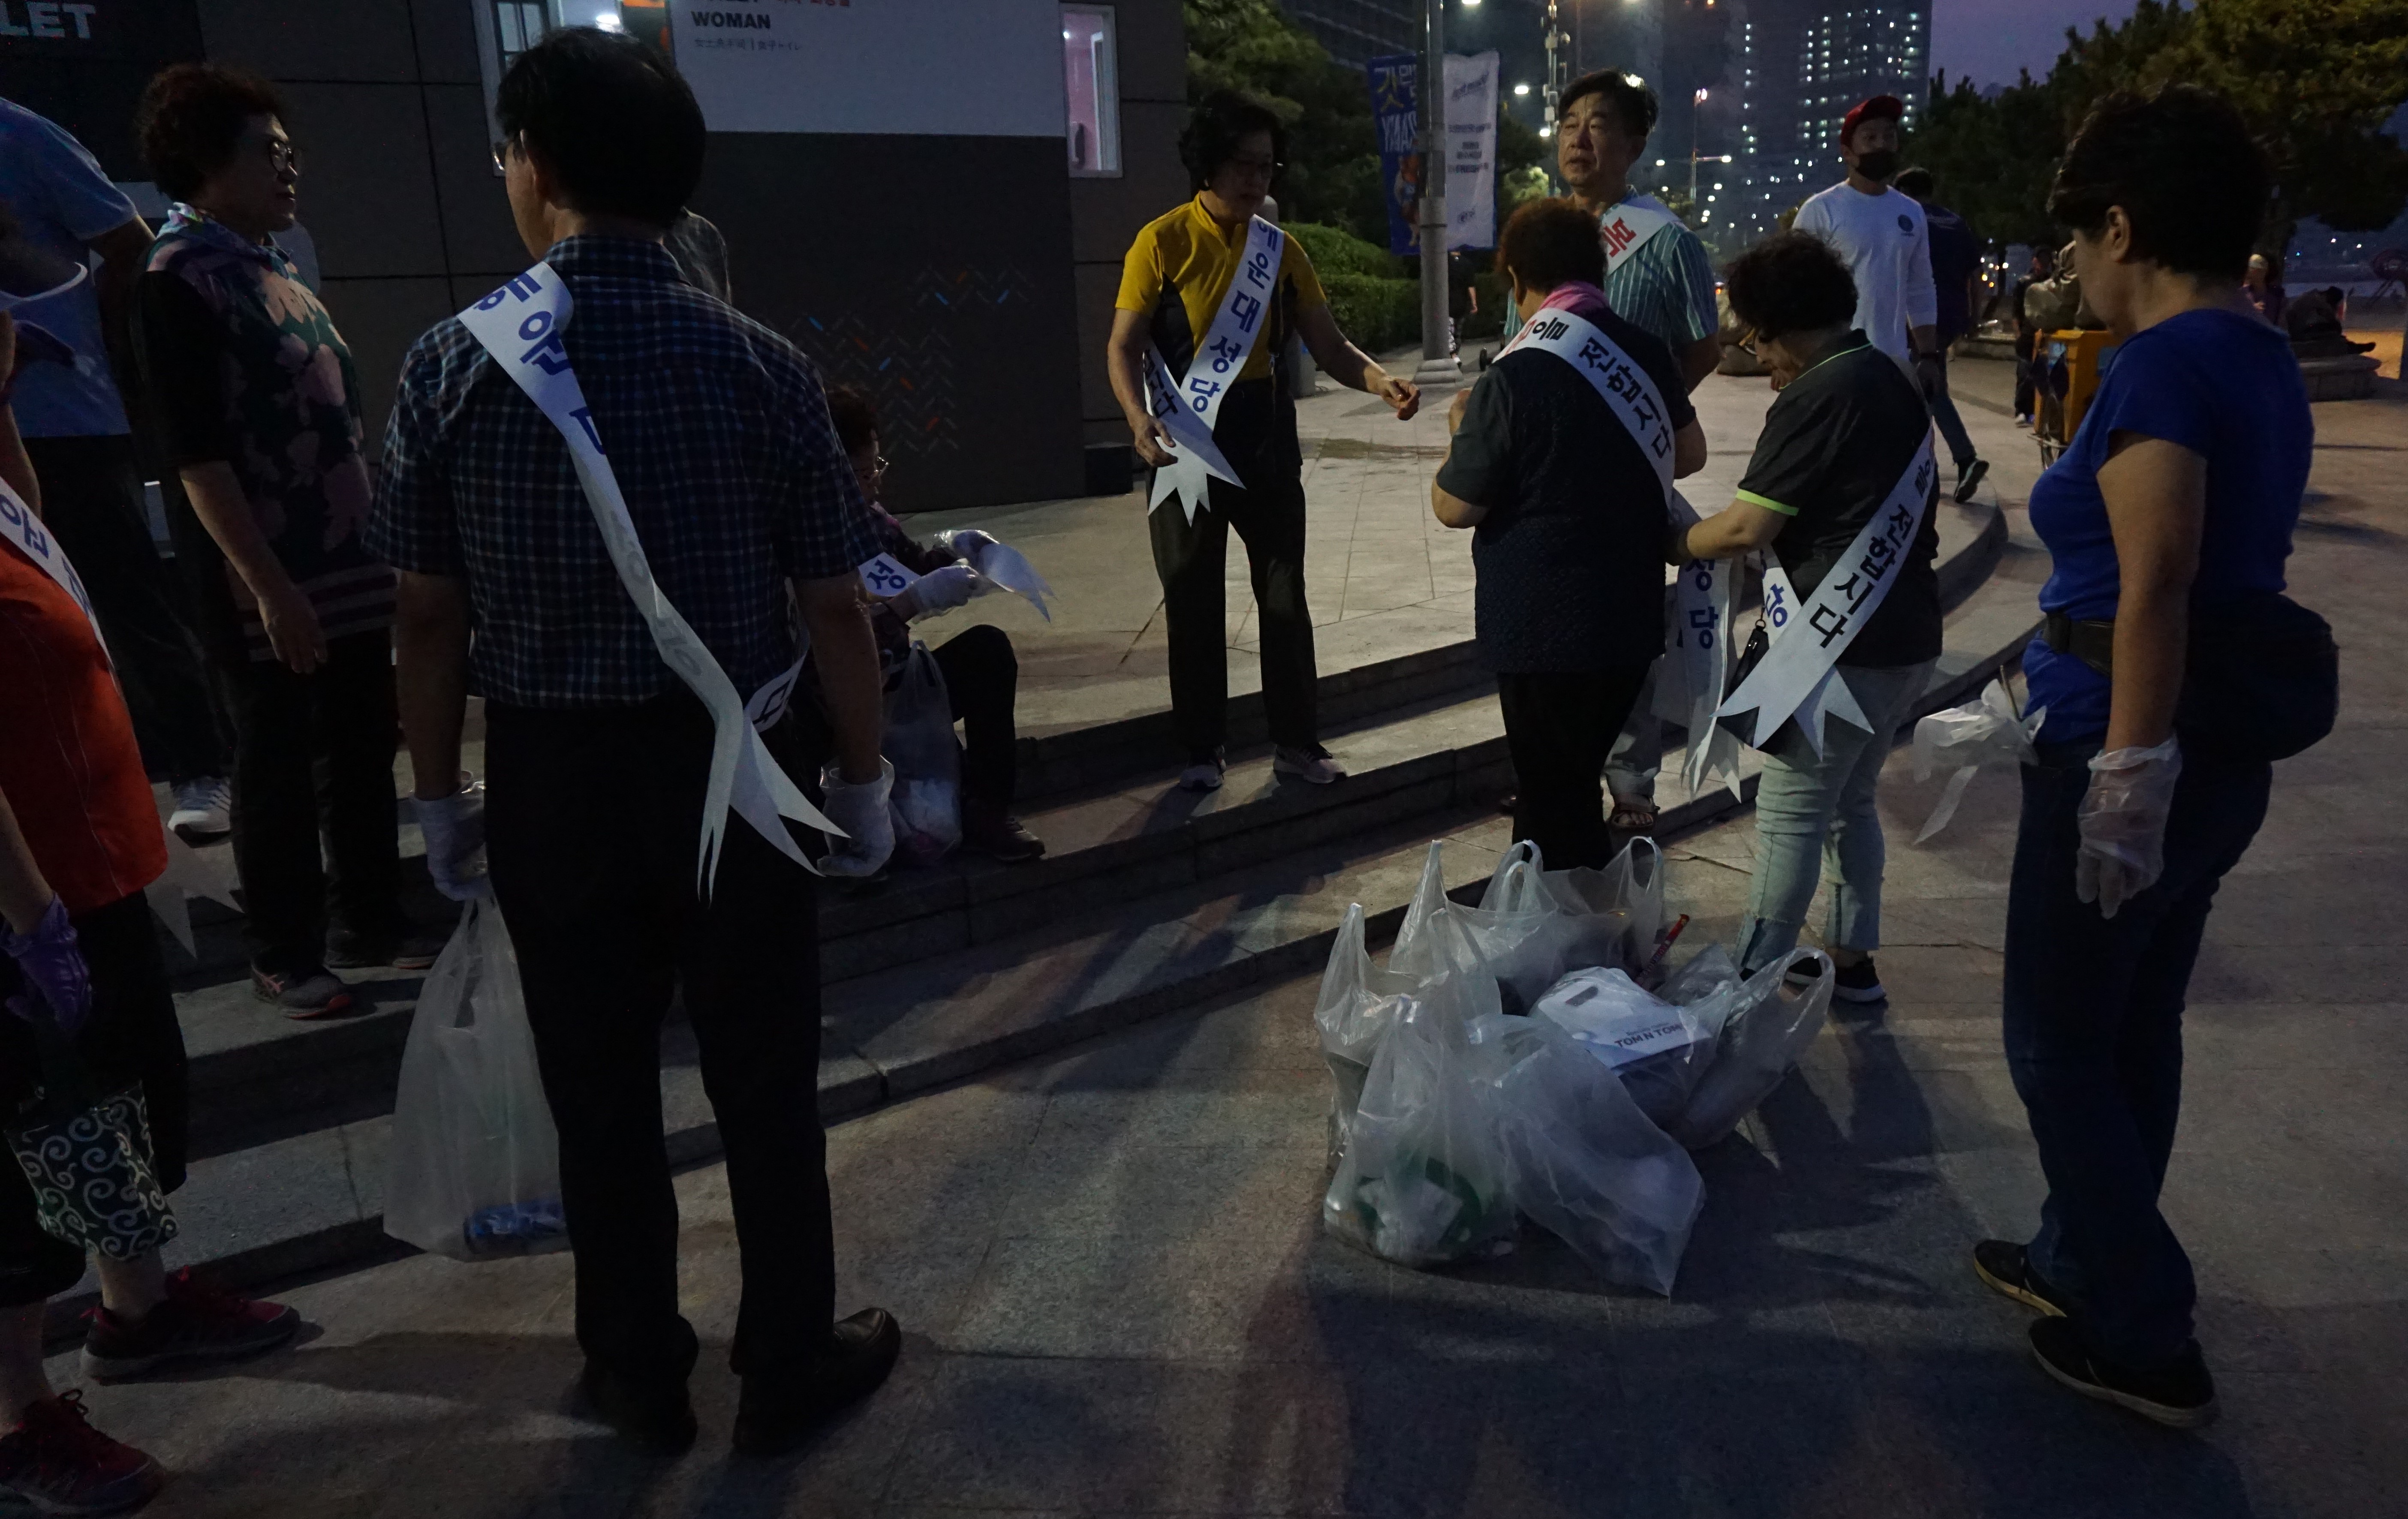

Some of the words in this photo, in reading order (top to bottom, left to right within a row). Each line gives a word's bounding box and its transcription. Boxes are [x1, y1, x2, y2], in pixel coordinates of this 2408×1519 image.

[0, 2, 96, 39] LET
[691, 10, 771, 29] WOMAN
[1579, 337, 1672, 459] 전합시다
[867, 559, 906, 590] 성
[1809, 504, 1914, 648] 전합시다
[1614, 1034, 1643, 1048] TOM
